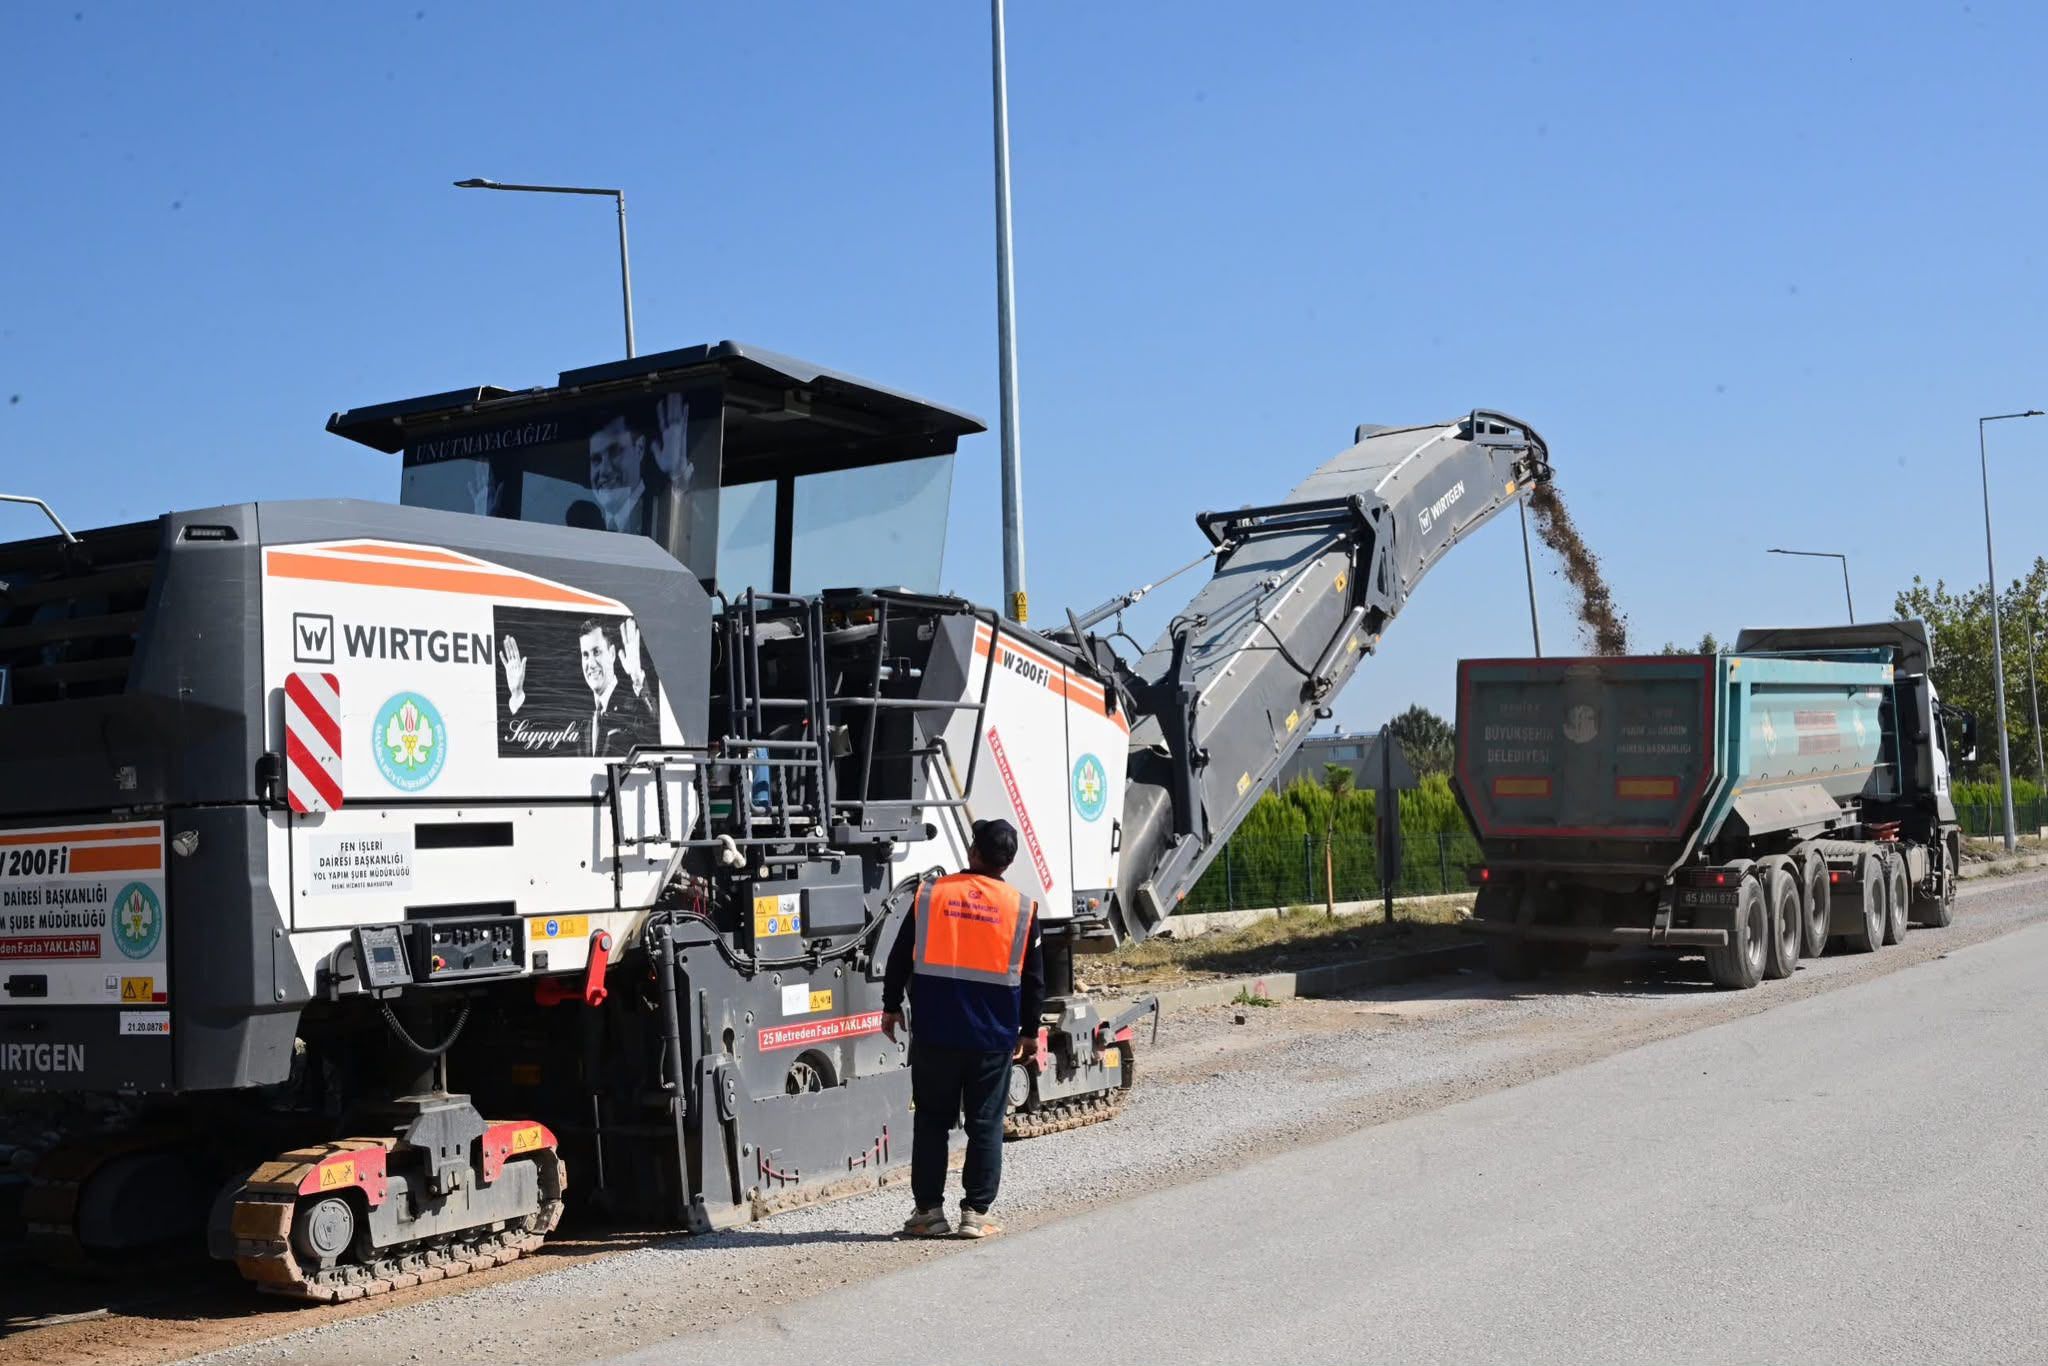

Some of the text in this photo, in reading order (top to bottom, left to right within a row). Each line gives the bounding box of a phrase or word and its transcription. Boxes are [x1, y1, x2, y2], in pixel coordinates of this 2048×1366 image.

[416, 422, 559, 463] UNUTMAYACAĞIZ!
[1430, 480, 1465, 520] WIRTGEN
[343, 624, 493, 665] WIRTGEN
[1004, 650, 1015, 669] W
[340, 838, 383, 853] FEN İŞLERİ
[319, 852, 404, 867] DAİRESİ BAŞKANLIĞI
[313, 866, 410, 881] YOL YAPIM ŞUBE MÜDÜRLÜĞÜ
[4, 883, 107, 909] DAİRESİ BAŞKANLIĞI
[10, 915, 35, 934] ŞUBE
[40, 909, 106, 928] MÜDÜRLÜĞÜ
[18, 941, 42, 953] Fazla
[43, 940, 96, 956] YAKLAŞMA
[763, 1033, 775, 1045] 25
[775, 1029, 816, 1043] Metreden
[817, 1023, 839, 1036] Fazla
[1, 1043, 84, 1072] IRTGEN
